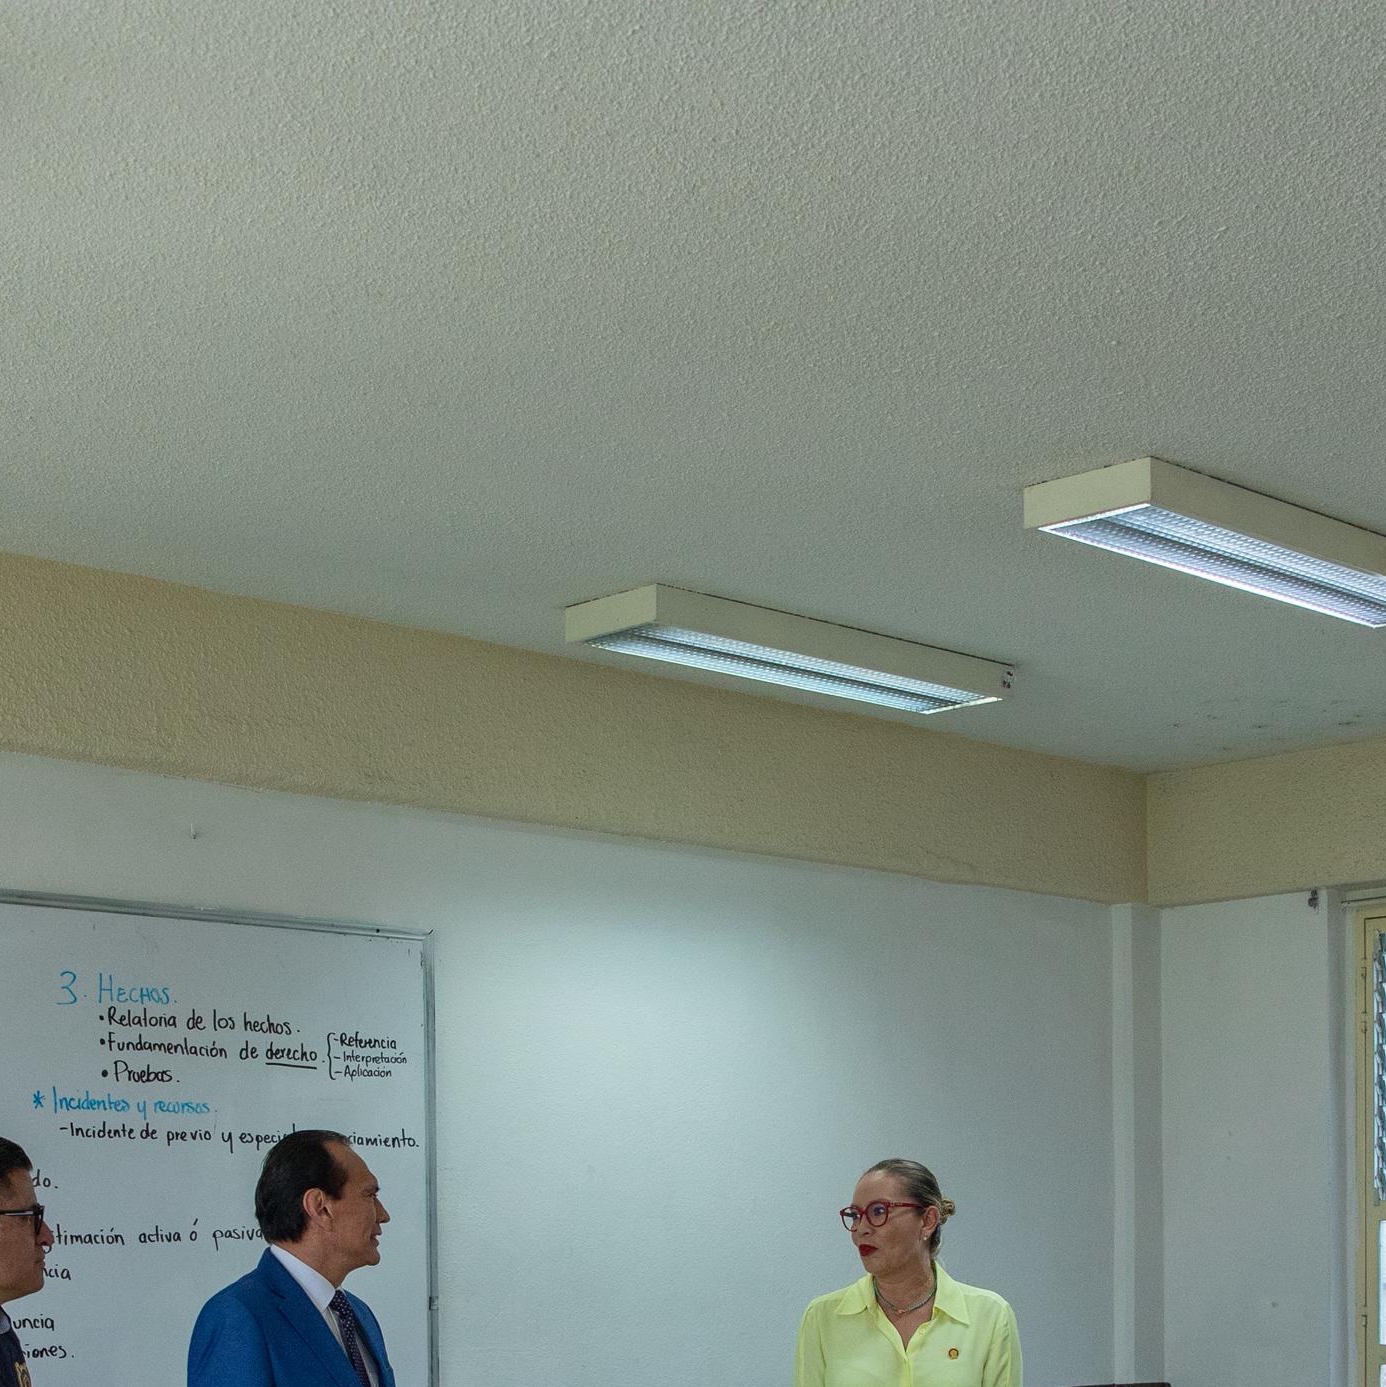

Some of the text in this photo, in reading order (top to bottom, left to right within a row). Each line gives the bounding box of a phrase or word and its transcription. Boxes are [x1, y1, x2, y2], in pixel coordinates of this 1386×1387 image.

[107, 1006, 300, 1035] Relatoria de los hechos.
[108, 1032, 228, 1059] Fundamentación
[239, 1040, 259, 1061] de
[53, 1085, 130, 1114] Incidentes
[136, 1101, 147, 1120] y
[140, 1122, 158, 1140] de
[166, 1127, 212, 1146] previo
[221, 1131, 234, 1154] y
[138, 1225, 181, 1244] activa
[189, 1218, 198, 1242] ó
